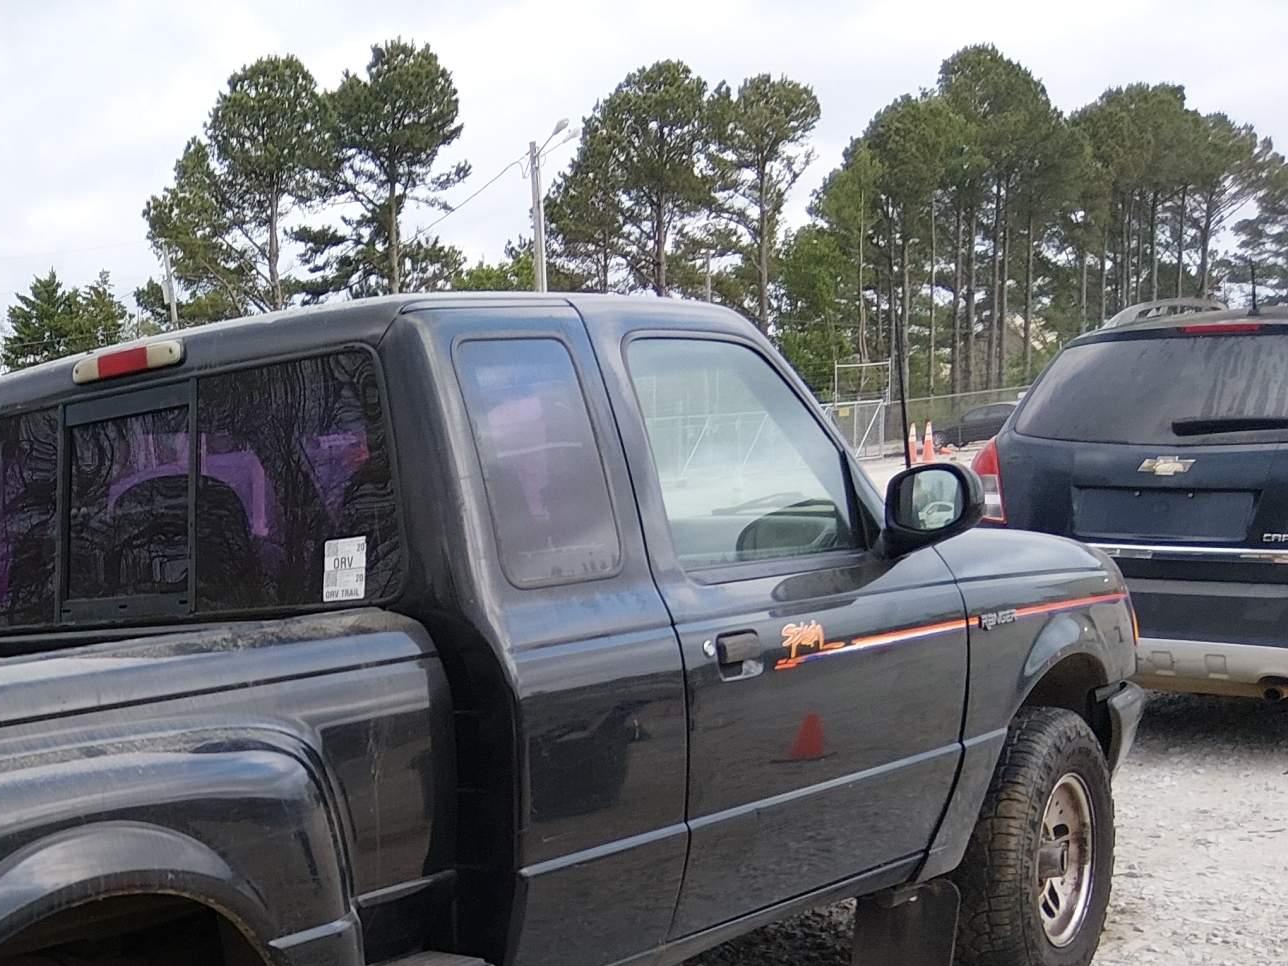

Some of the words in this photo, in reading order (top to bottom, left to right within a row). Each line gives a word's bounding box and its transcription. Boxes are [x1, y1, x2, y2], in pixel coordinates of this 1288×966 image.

[356, 543, 365, 552] 20
[333, 556, 354, 569] ORV
[325, 589, 339, 599] ORV
[340, 588, 360, 599] TRAIL
[981, 608, 1017, 631] RANGER
